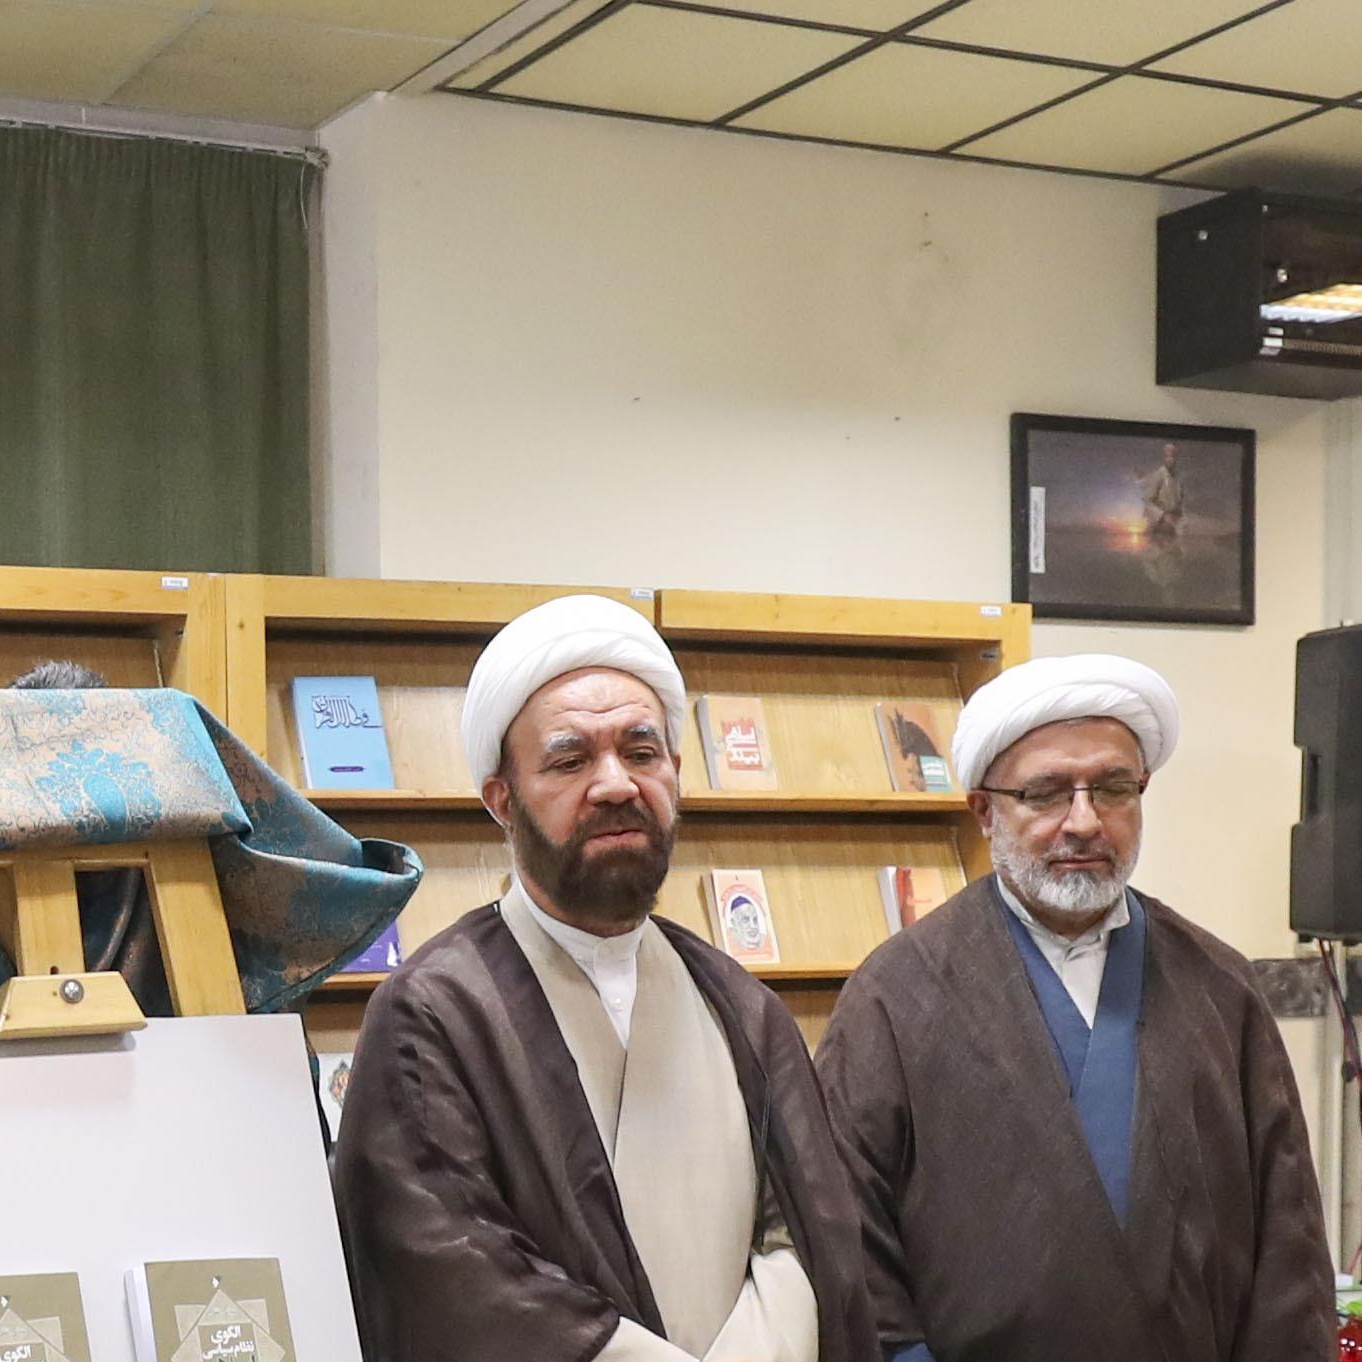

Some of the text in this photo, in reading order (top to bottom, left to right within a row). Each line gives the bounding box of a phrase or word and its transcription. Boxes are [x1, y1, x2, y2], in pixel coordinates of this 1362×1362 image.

[210, 1325, 242, 1345] الگوی
[202, 1340, 255, 1360] نظام سیاسی
